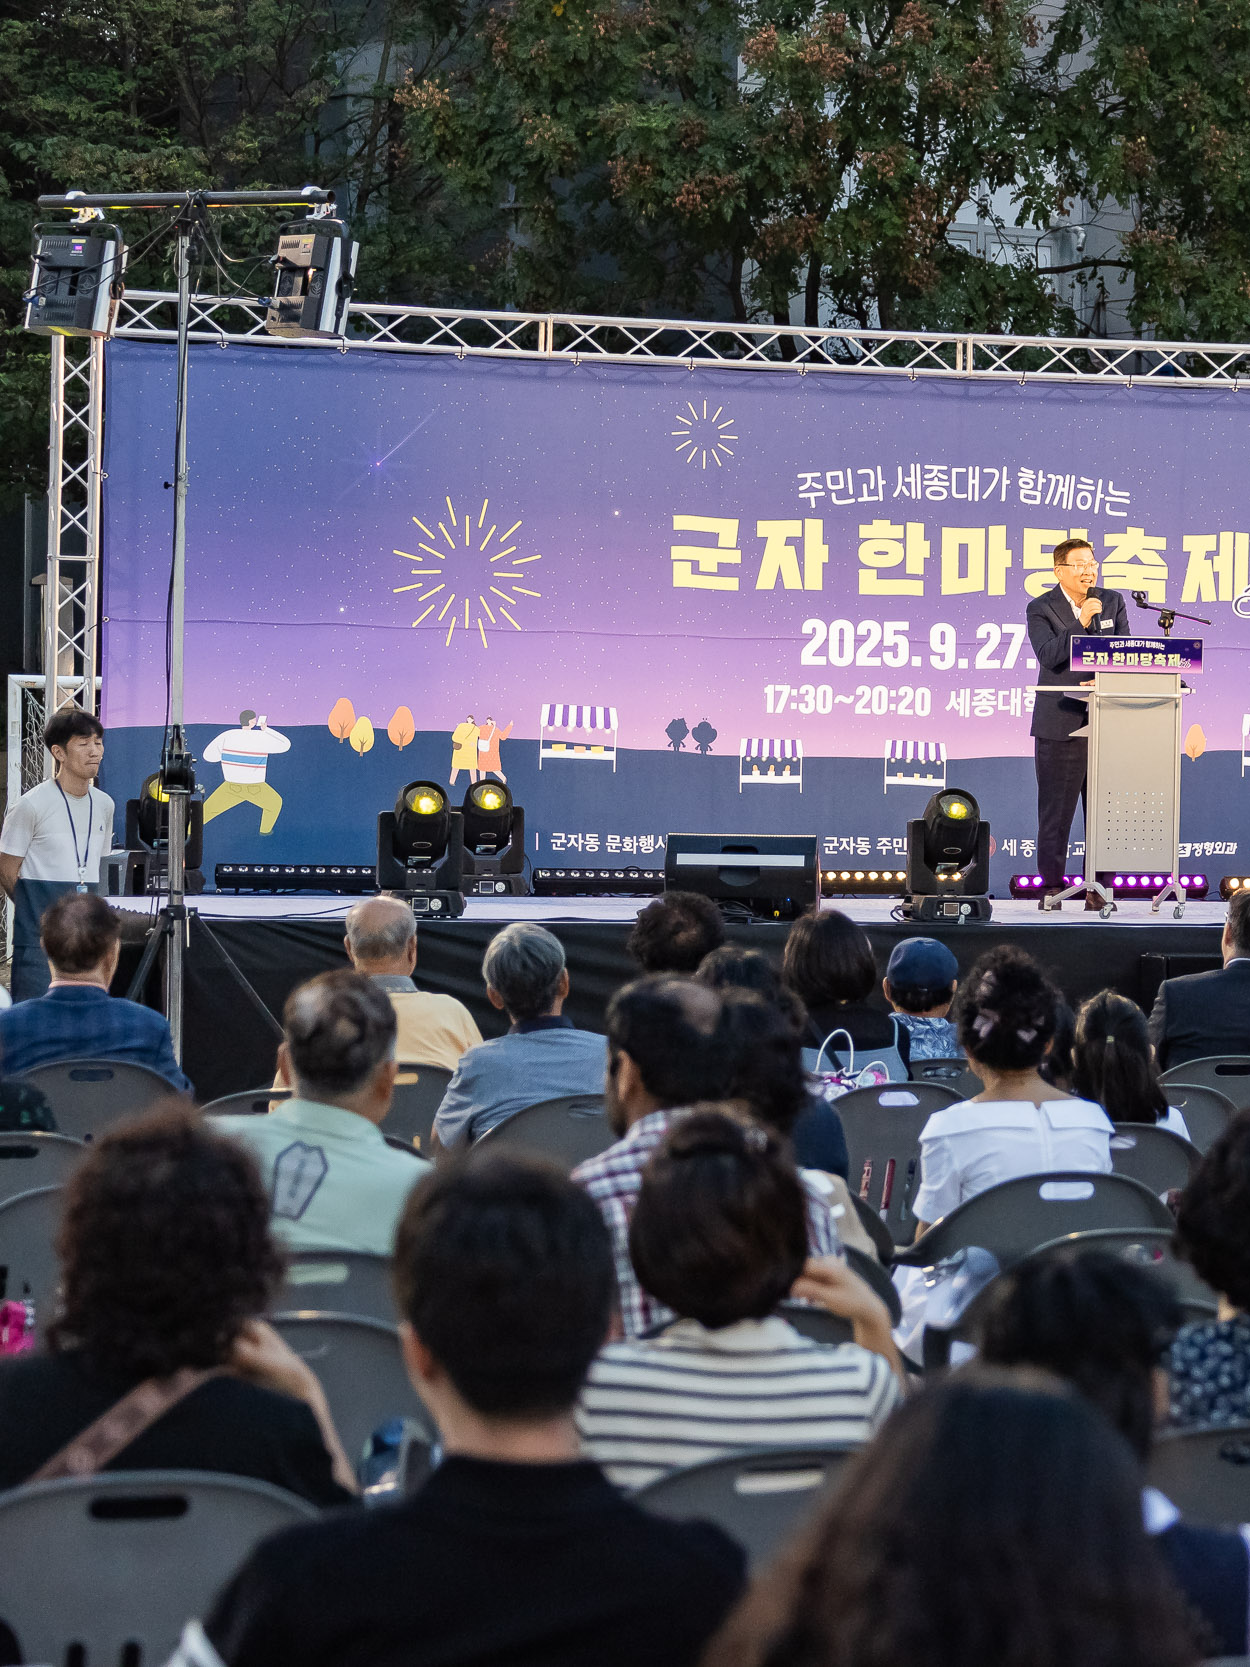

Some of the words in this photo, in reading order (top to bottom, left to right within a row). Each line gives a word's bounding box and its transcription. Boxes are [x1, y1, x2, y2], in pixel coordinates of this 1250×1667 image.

[797, 465, 886, 508] 주민과
[893, 463, 1010, 501] 세종대가
[1017, 466, 1131, 517] 함께하는
[670, 515, 829, 591] 군자
[1082, 651, 1109, 666] 군자
[1112, 652, 1180, 667] 한마당축제
[764, 684, 932, 717] 17:30~20:20
[550, 832, 601, 852] 군자동
[823, 836, 871, 856] 군자동
